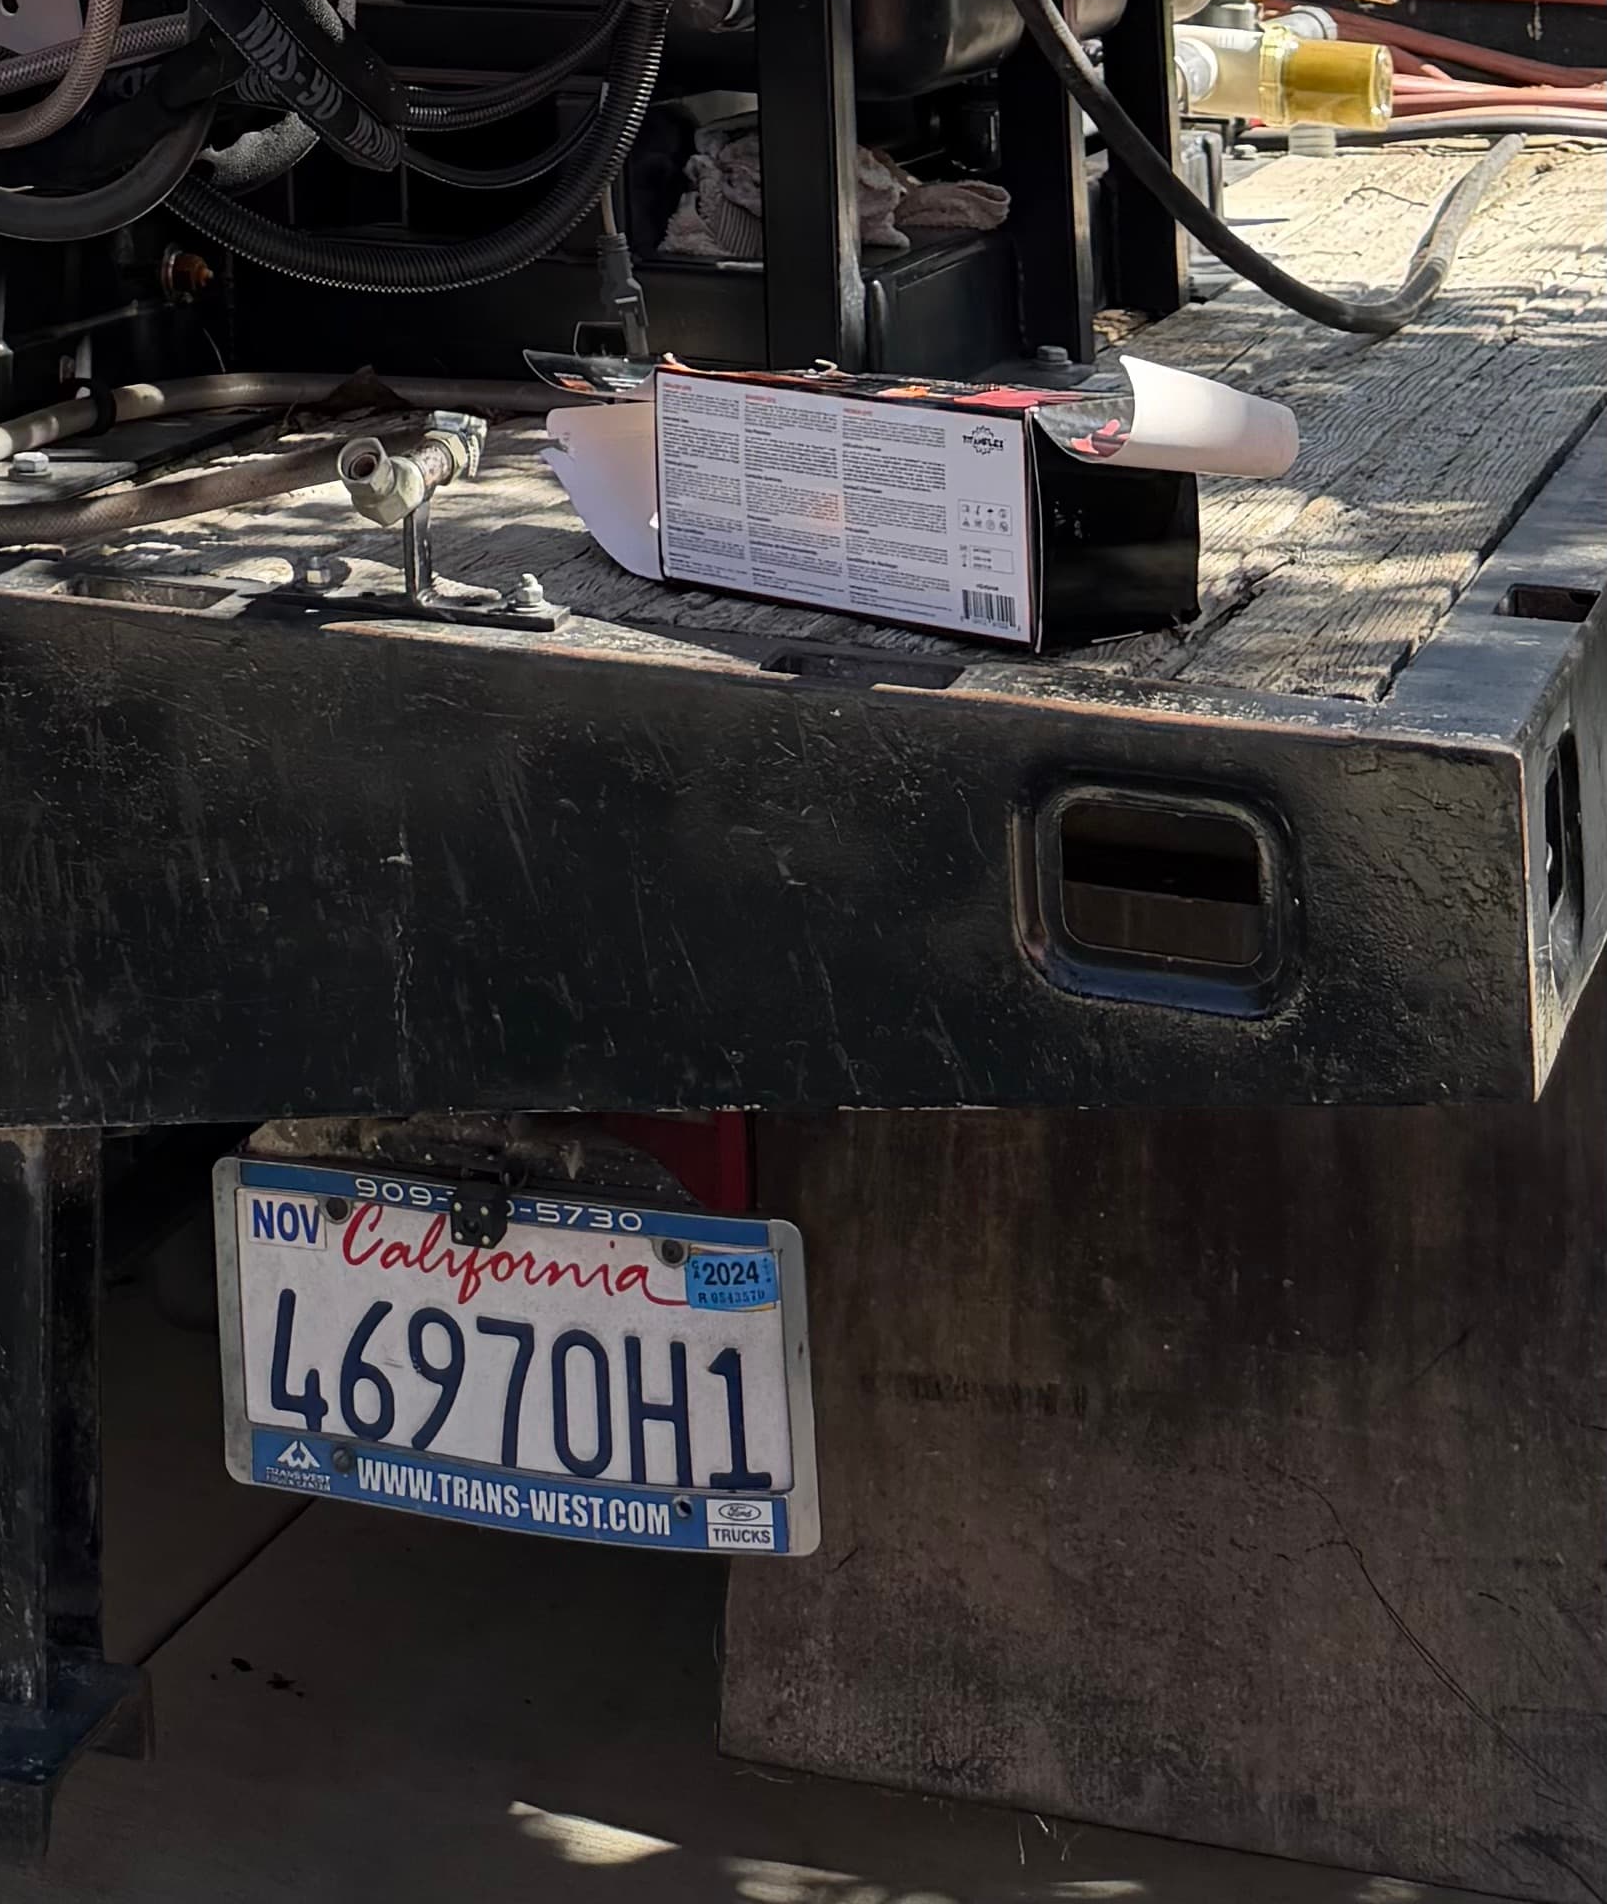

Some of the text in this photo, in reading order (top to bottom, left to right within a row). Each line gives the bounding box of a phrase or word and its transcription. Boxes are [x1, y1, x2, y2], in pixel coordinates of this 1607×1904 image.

[253, 1199, 319, 1244] NOV
[355, 1178, 642, 1232] 909--5730
[342, 1201, 688, 1306] California
[702, 1260, 760, 1286] 2024
[271, 1288, 772, 1489] 46970H1
[357, 1457, 671, 1536] WWW.TRANS-WEST.COM
[726, 1504, 753, 1518] Ford
[712, 1527, 771, 1544] TRUCKS
